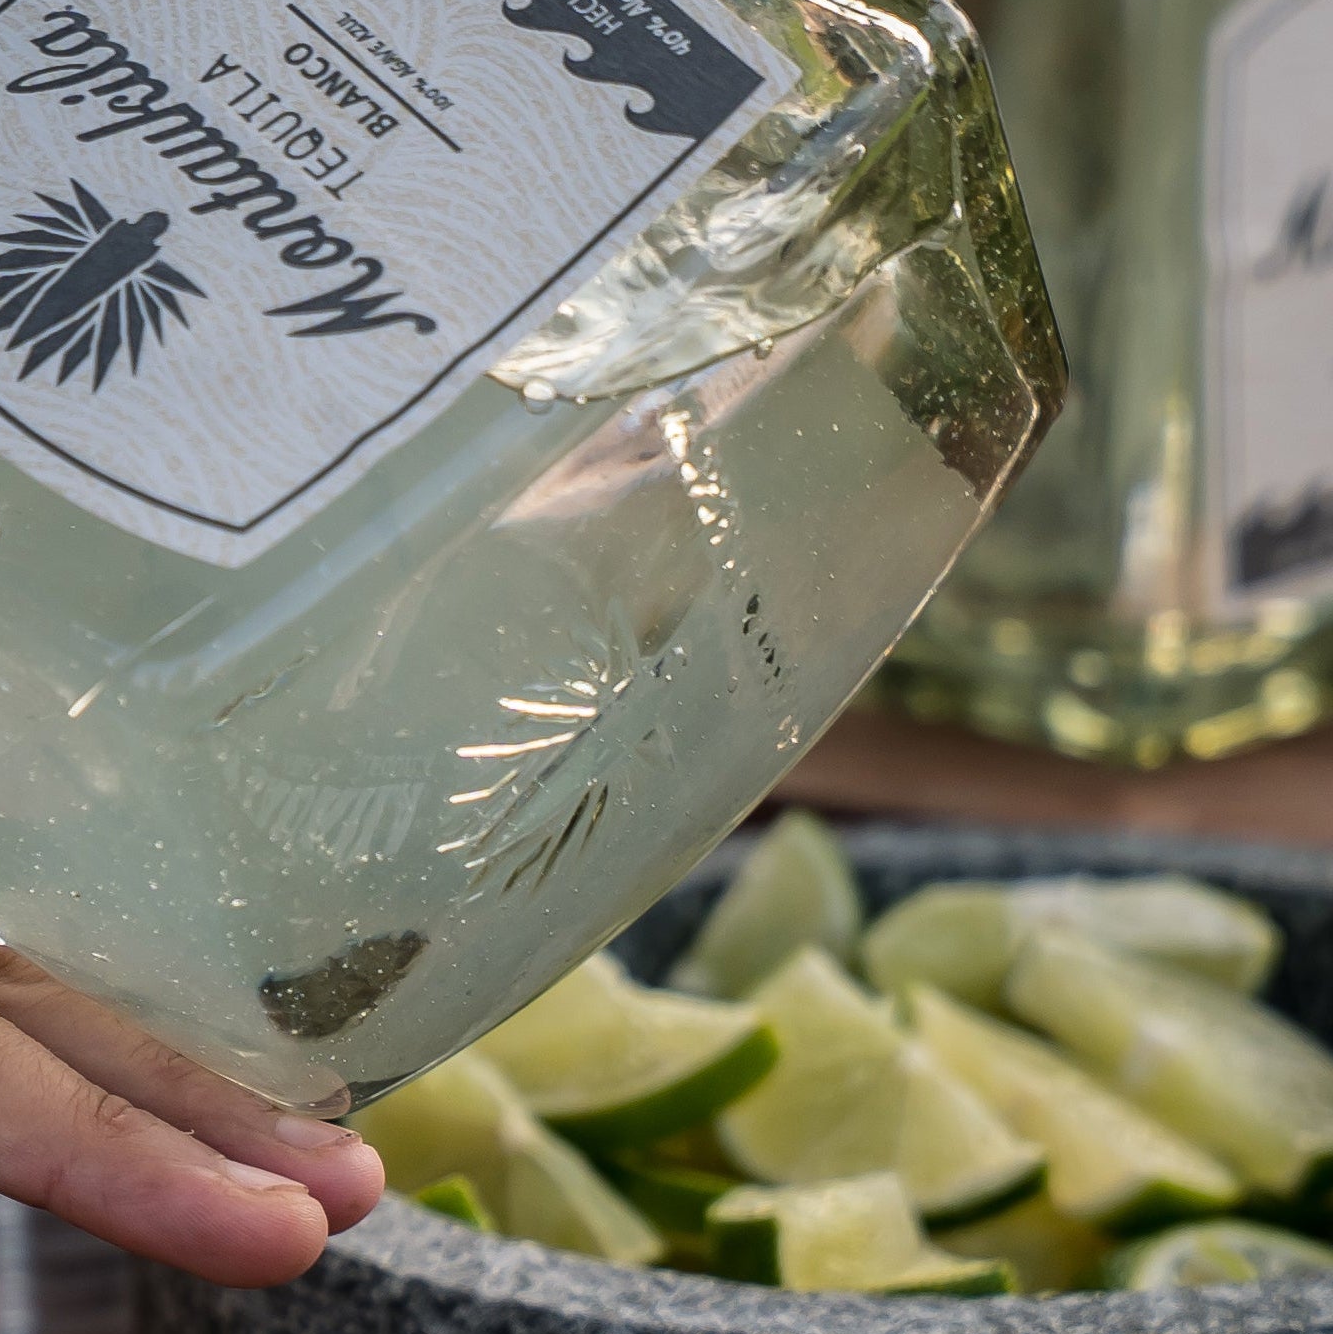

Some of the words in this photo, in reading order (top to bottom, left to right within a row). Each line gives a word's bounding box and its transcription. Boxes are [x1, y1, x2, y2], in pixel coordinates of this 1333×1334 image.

[336, 11, 375, 43] AZUL
[645, 14, 692, 56] 40%
[366, 40, 417, 79] AGAVE
[282, 41, 402, 139] BLANCO
[411, 77, 455, 112] 100%
[199, 53, 365, 201] TEQUILA
[4, 10, 438, 338] Montaukila
